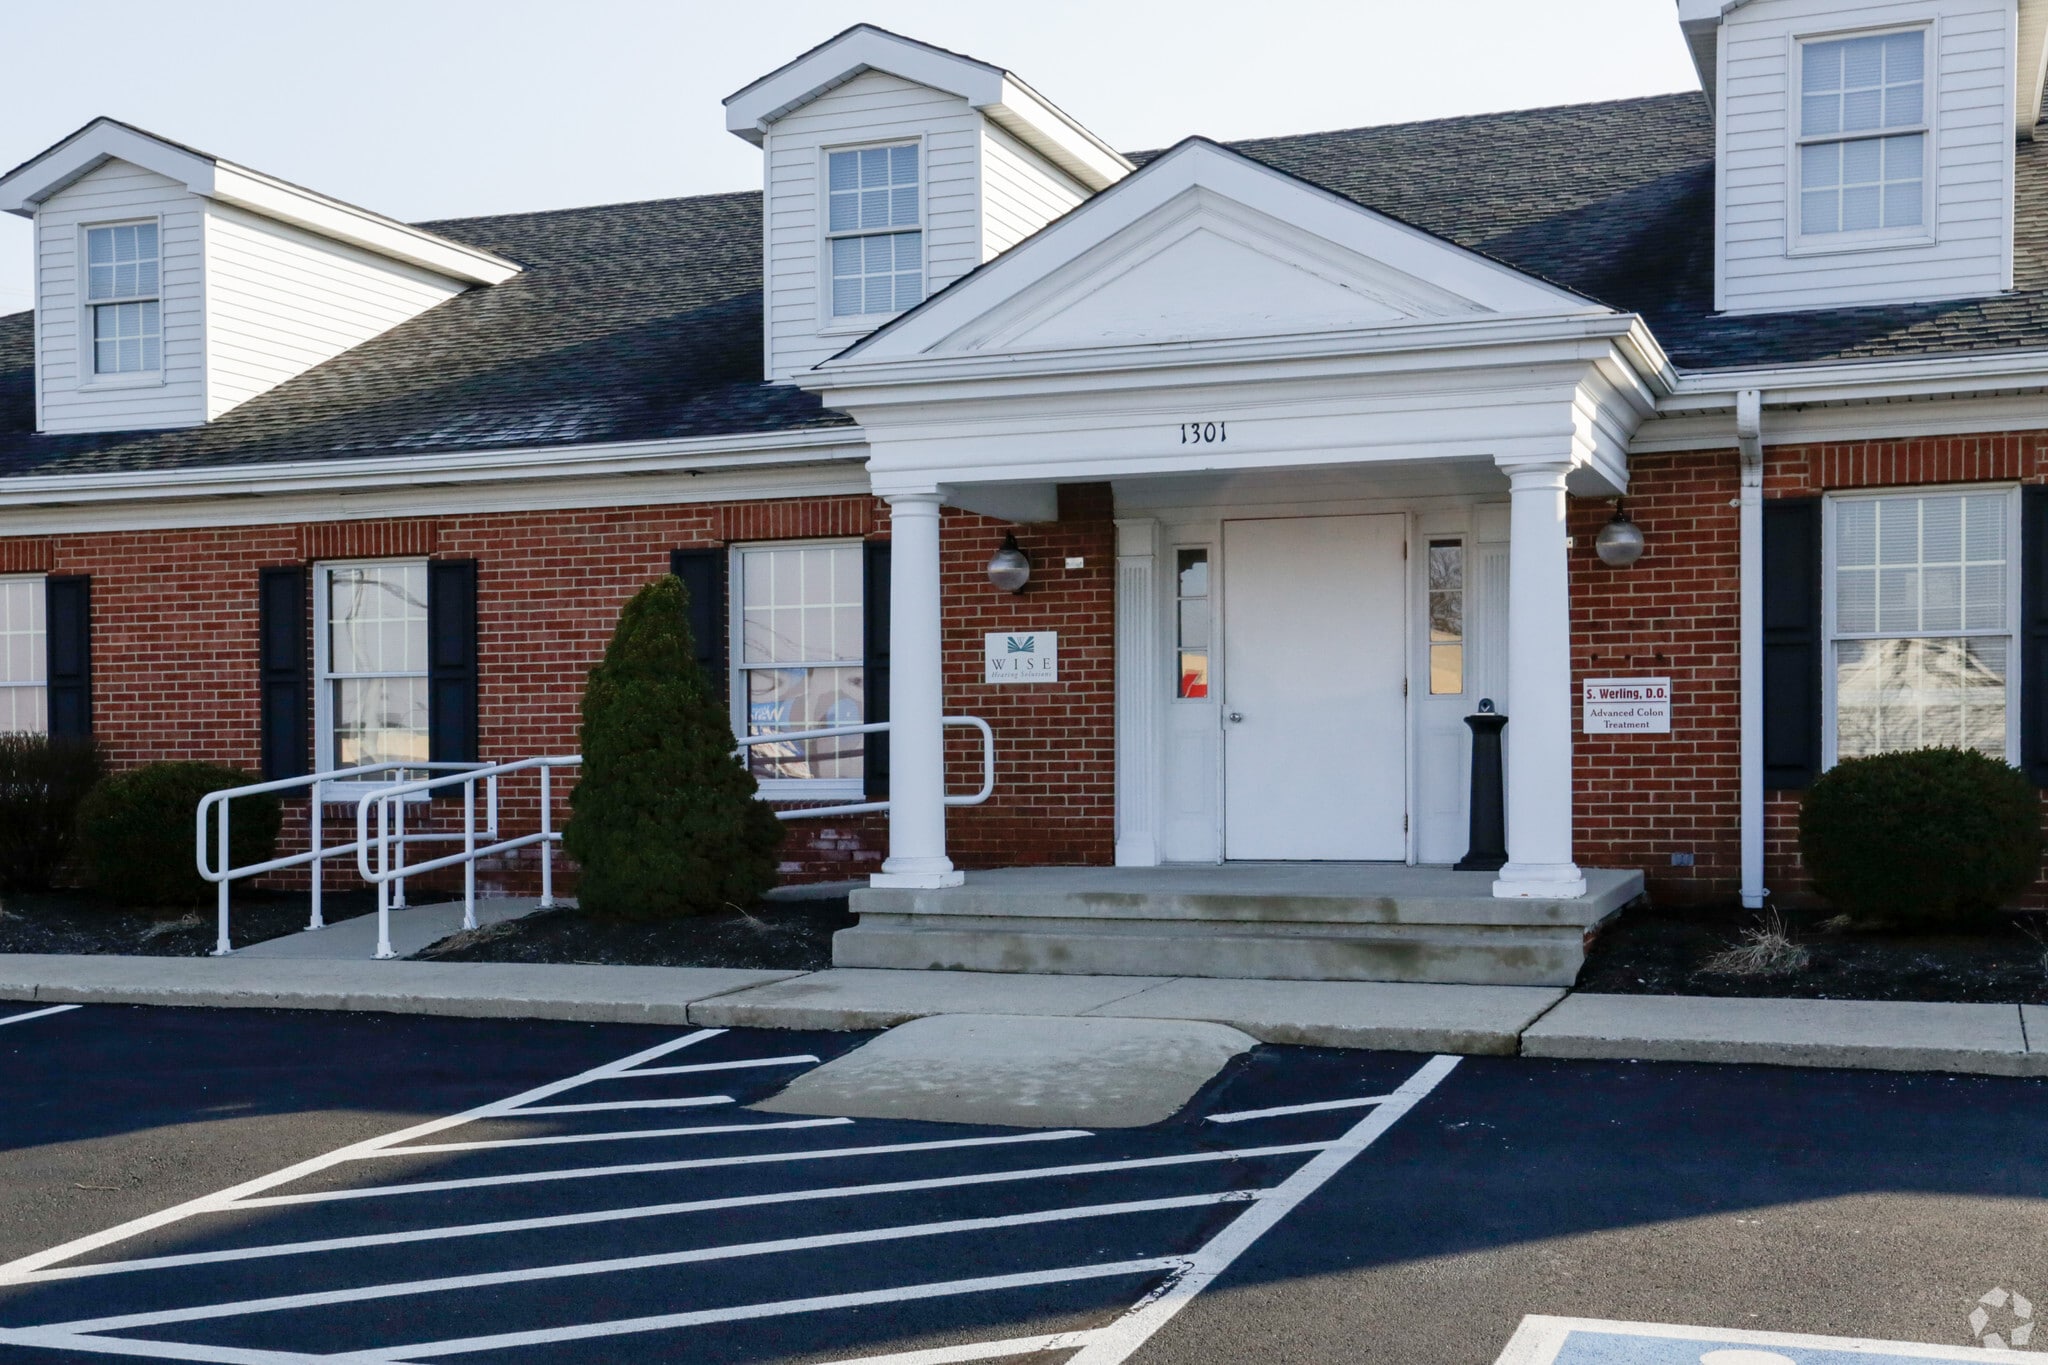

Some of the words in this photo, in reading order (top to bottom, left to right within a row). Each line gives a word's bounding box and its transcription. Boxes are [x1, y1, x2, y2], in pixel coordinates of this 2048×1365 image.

[1181, 421, 1226, 444] 1301
[991, 658, 1051, 670] WISE
[1586, 689, 1596, 699] S.
[1599, 688, 1642, 700] Werling,
[1646, 688, 1667, 698] D.O.
[1590, 709, 1634, 717] Advanced
[1637, 708, 1664, 716] Colon
[1604, 720, 1650, 728] Treatment
